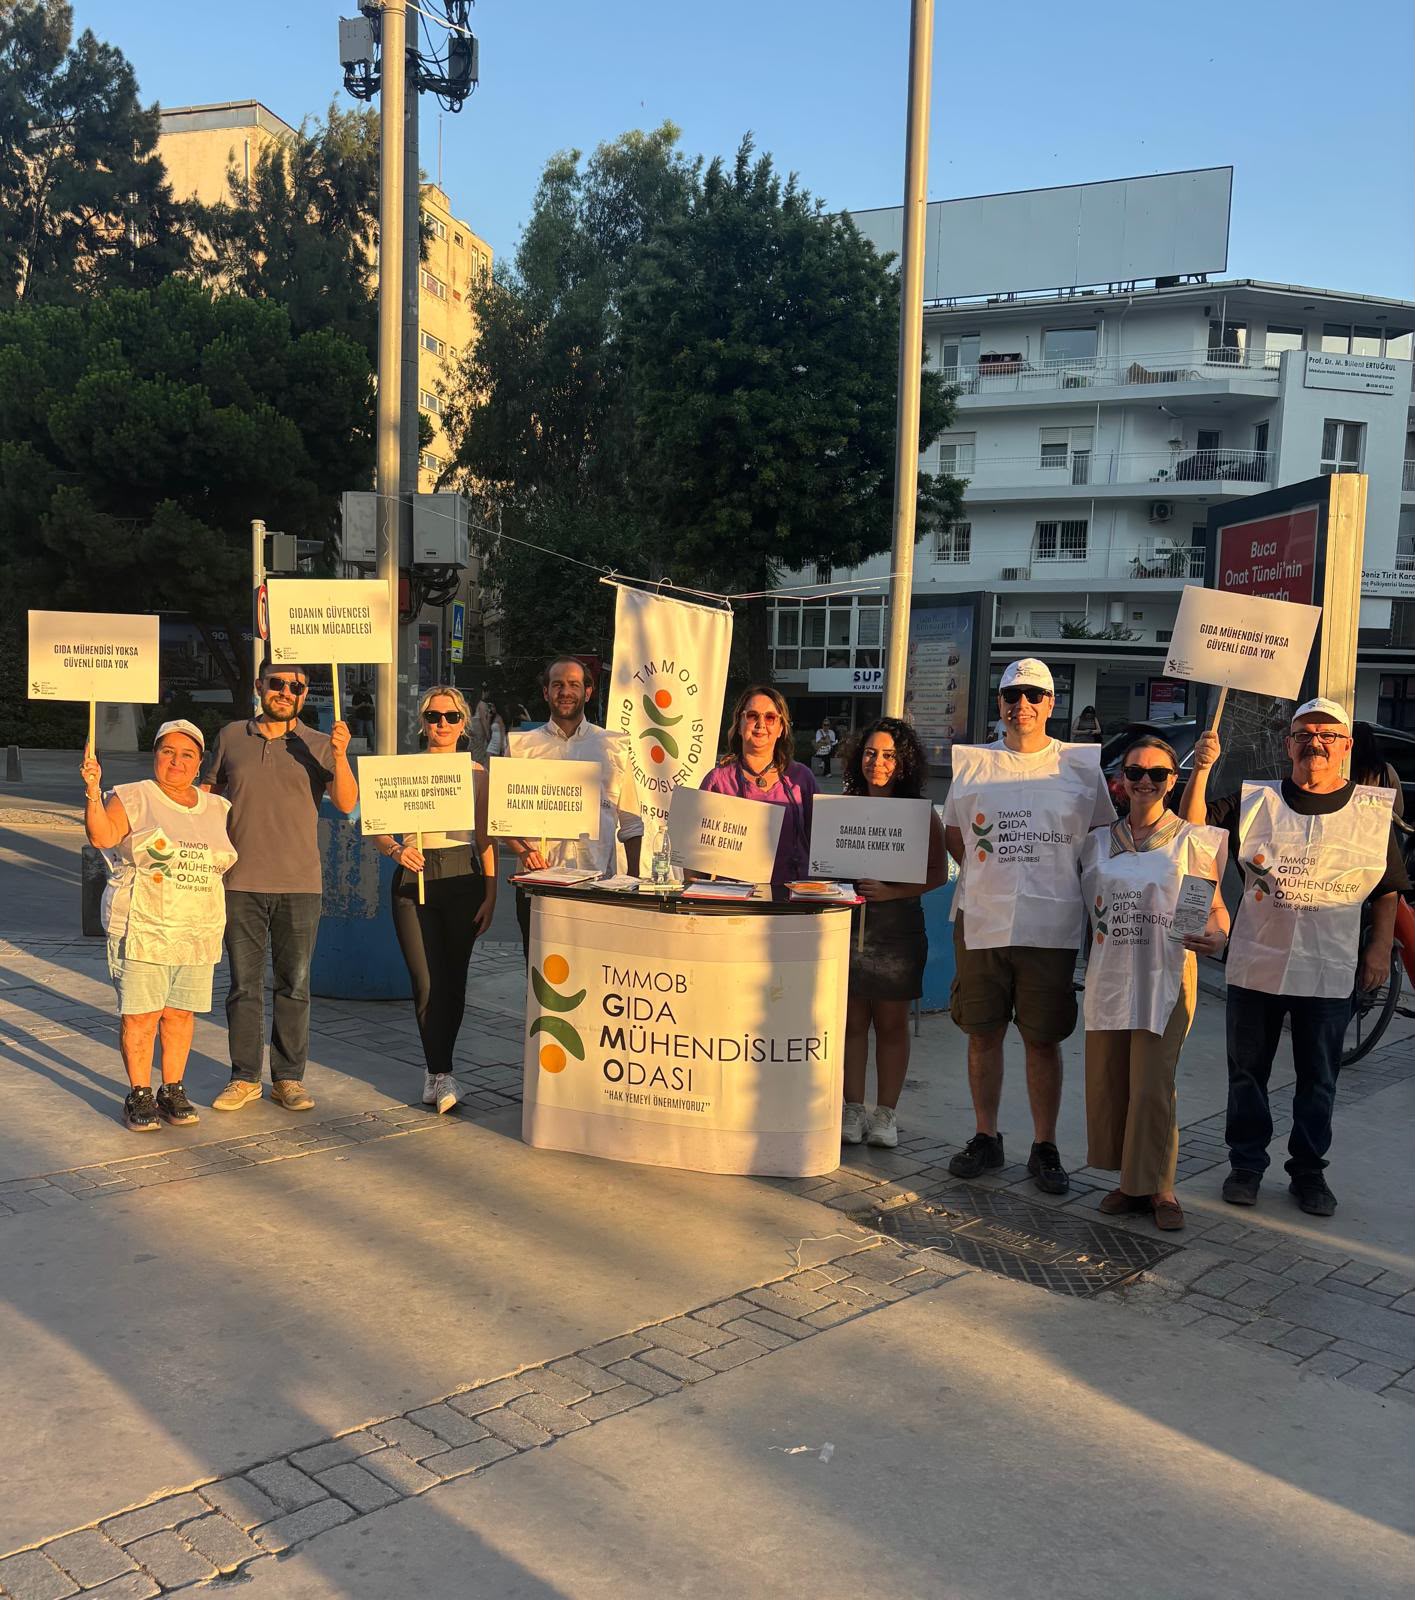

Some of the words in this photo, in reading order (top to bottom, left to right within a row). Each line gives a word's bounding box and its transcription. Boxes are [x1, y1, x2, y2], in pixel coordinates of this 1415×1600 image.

[1366, 362, 1396, 371] ERTUĞRUL
[1250, 541, 1277, 558] Buca
[1225, 570, 1249, 586] Onat
[1382, 571, 1397, 580] Tirit
[289, 608, 323, 618] GIDANIN
[326, 606, 370, 618] GÜVENCESİ
[290, 623, 319, 634] HALKIN
[322, 622, 372, 634] MÜCADELESİ
[1200, 623, 1218, 636] GIDA
[1220, 626, 1264, 644] MÜHENDİSİ
[1264, 634, 1289, 648] YOKSA
[54, 644, 71, 654] GIDA
[73, 644, 114, 656] MÜHENDİSİ
[116, 646, 138, 656] YOKSA
[1206, 639, 1239, 654] GÜVENLİ
[1240, 645, 1258, 657] GIDA
[1260, 649, 1276, 660] YOK
[64, 657, 94, 668] GÜVENLİ
[96, 659, 113, 668] GIDA
[115, 660, 128, 669] YOK
[633, 660, 698, 696] TMMOB
[688, 718, 704, 764] ODASI
[375, 776, 428, 788] “ÇALIŞTIRILMASI
[431, 774, 461, 783] ZORUNLU
[375, 790, 398, 801] YAŞAM
[400, 789, 419, 798] HAKKI
[421, 786, 462, 797] OPSİYONEL”
[507, 784, 538, 795] GIDANIN
[541, 784, 582, 797] GÜVENCESİ
[404, 801, 435, 810] PERSONEL
[507, 798, 534, 810] HALKIN
[536, 798, 582, 812] MÜCADELESİ
[998, 810, 1032, 819] TMMOB
[701, 817, 721, 831] HALK
[722, 822, 748, 836] BENİM
[840, 825, 866, 836] SAHADA
[868, 826, 886, 836] EMEK
[888, 828, 902, 837] VAR
[998, 820, 1027, 830] GIDA
[178, 841, 208, 850] TMMOB
[700, 833, 716, 846] HAK
[718, 836, 742, 851] BENİM
[836, 838, 866, 850] SOFRADA
[868, 840, 890, 851] EKMEK
[892, 842, 905, 852] YOK
[180, 850, 204, 860] GIDA
[998, 845, 1033, 855] ODASI
[1280, 855, 1316, 865] TMMOB
[1278, 866, 1309, 876] GIDA
[177, 874, 208, 884] ODASI
[1275, 877, 1360, 893] MÜHENDİSLERİ
[1112, 890, 1142, 900] TMMOB
[1275, 890, 1313, 902] ODASI
[1112, 901, 1137, 911] GIDA
[1112, 926, 1142, 937] ODASI
[602, 964, 688, 993] TMMOB
[602, 993, 676, 1024] GIDA
[600, 1025, 828, 1062] MÜHENDİSLERİ
[603, 1059, 692, 1092] ODASI
[604, 1089, 623, 1101] “HAK
[625, 1093, 651, 1105] YEMEYİ
[653, 1094, 711, 1112] ÖNERMİYORUZ”
